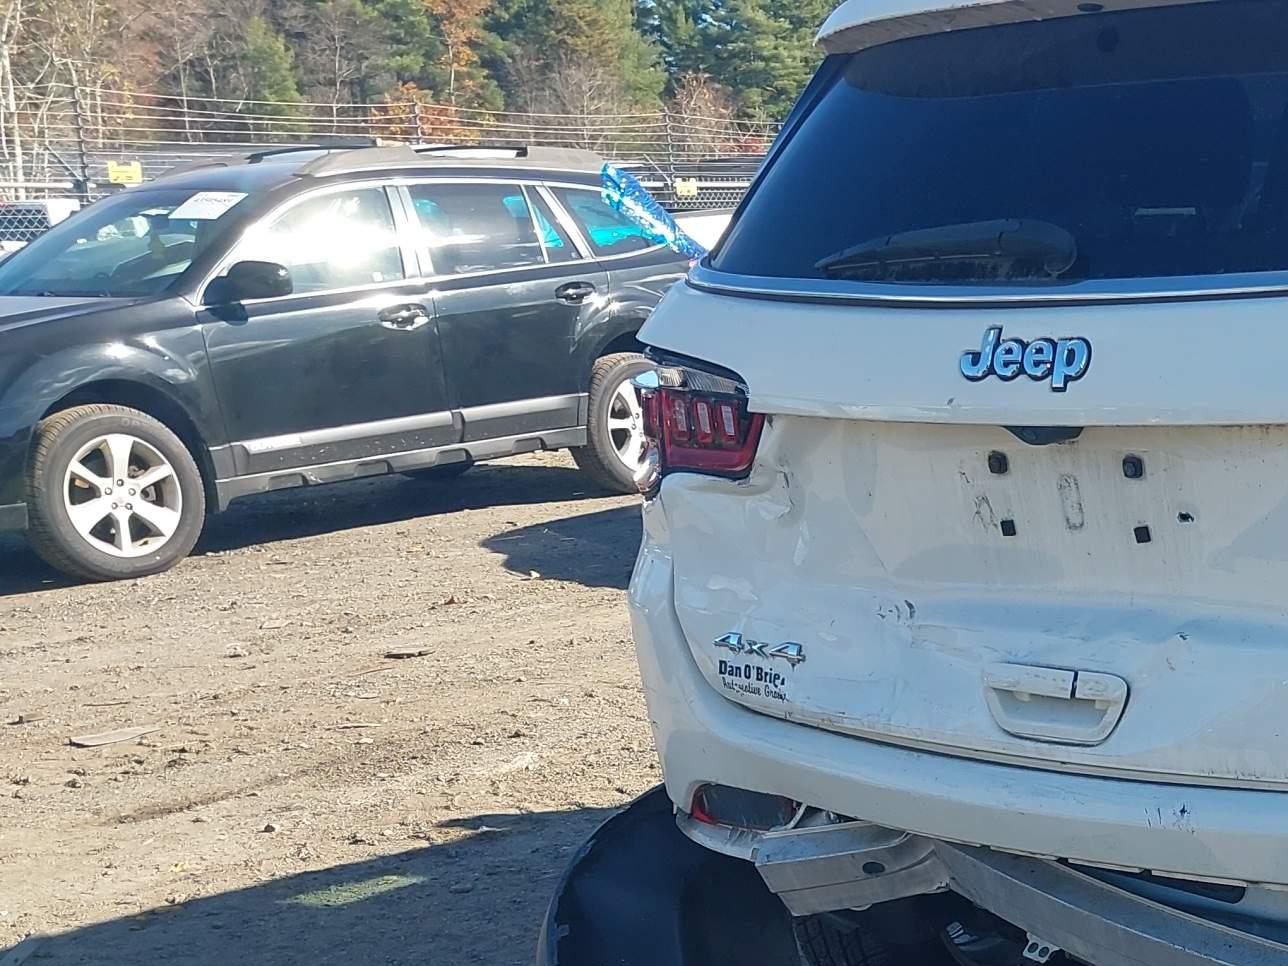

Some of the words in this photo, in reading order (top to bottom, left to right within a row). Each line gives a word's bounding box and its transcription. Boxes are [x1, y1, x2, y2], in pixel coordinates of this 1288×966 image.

[959, 325, 1092, 392] Jeep
[713, 631, 806, 665] 4x4
[718, 659, 742, 678] Dan
